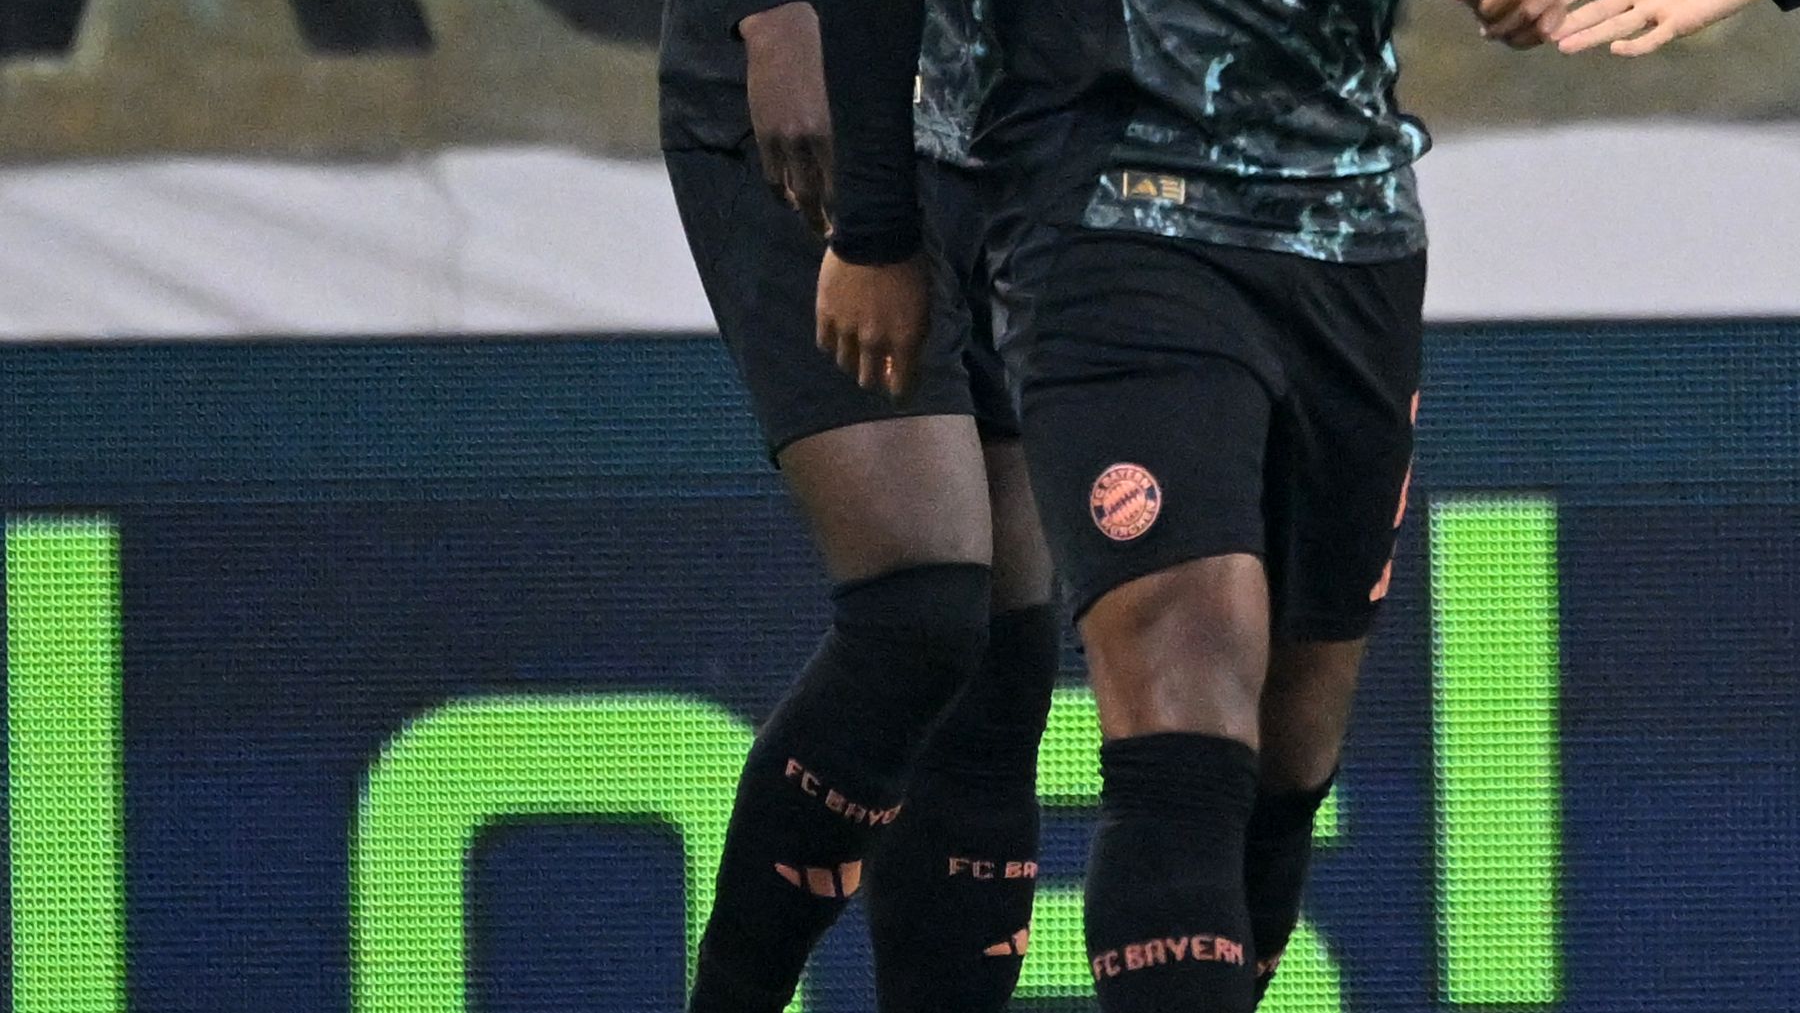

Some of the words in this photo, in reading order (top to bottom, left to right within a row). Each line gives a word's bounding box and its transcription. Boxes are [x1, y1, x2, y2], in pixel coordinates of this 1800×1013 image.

[785, 757, 821, 797] FC
[948, 856, 995, 880] FC
[1004, 860, 1039, 880] BA
[1092, 949, 1121, 981] FC
[1123, 934, 1245, 967] BAYERN
